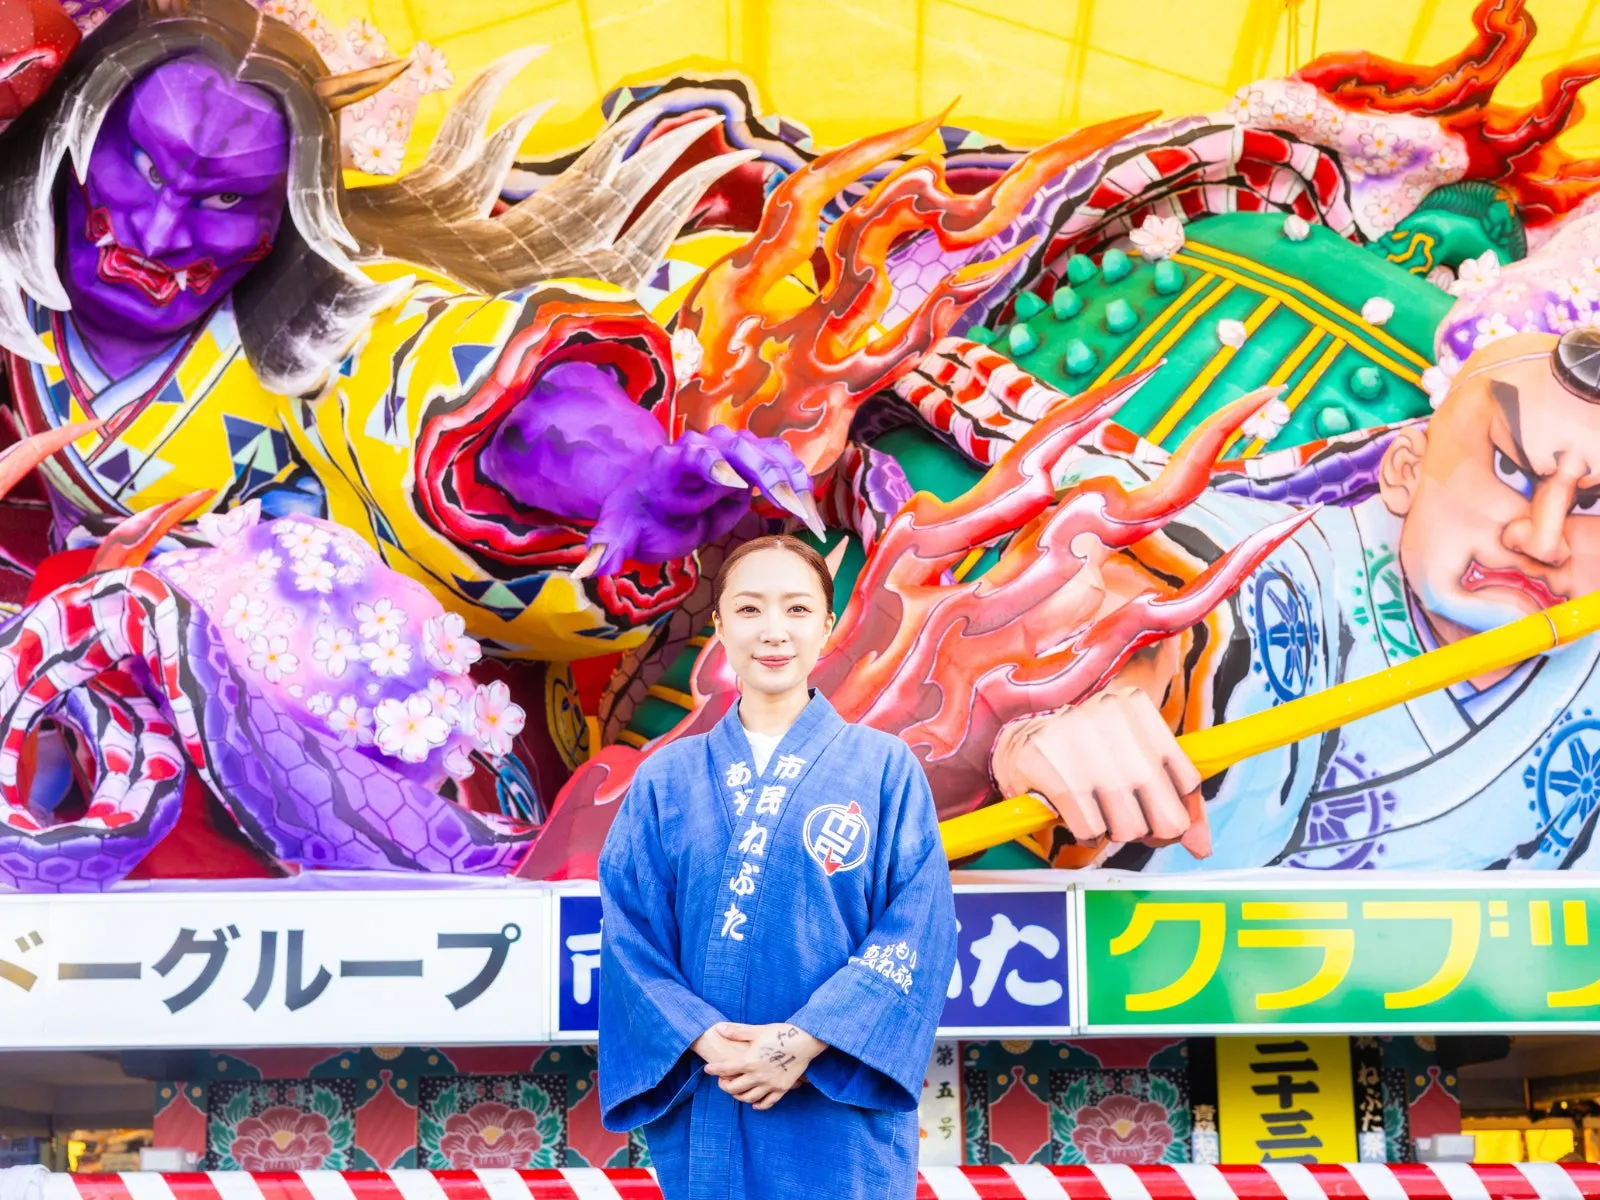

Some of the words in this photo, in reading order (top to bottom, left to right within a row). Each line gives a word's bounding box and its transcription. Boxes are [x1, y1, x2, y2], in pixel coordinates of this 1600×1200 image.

[721, 754, 807, 941] 市民ねぶた
[935, 1044, 955, 1140] 第五号
